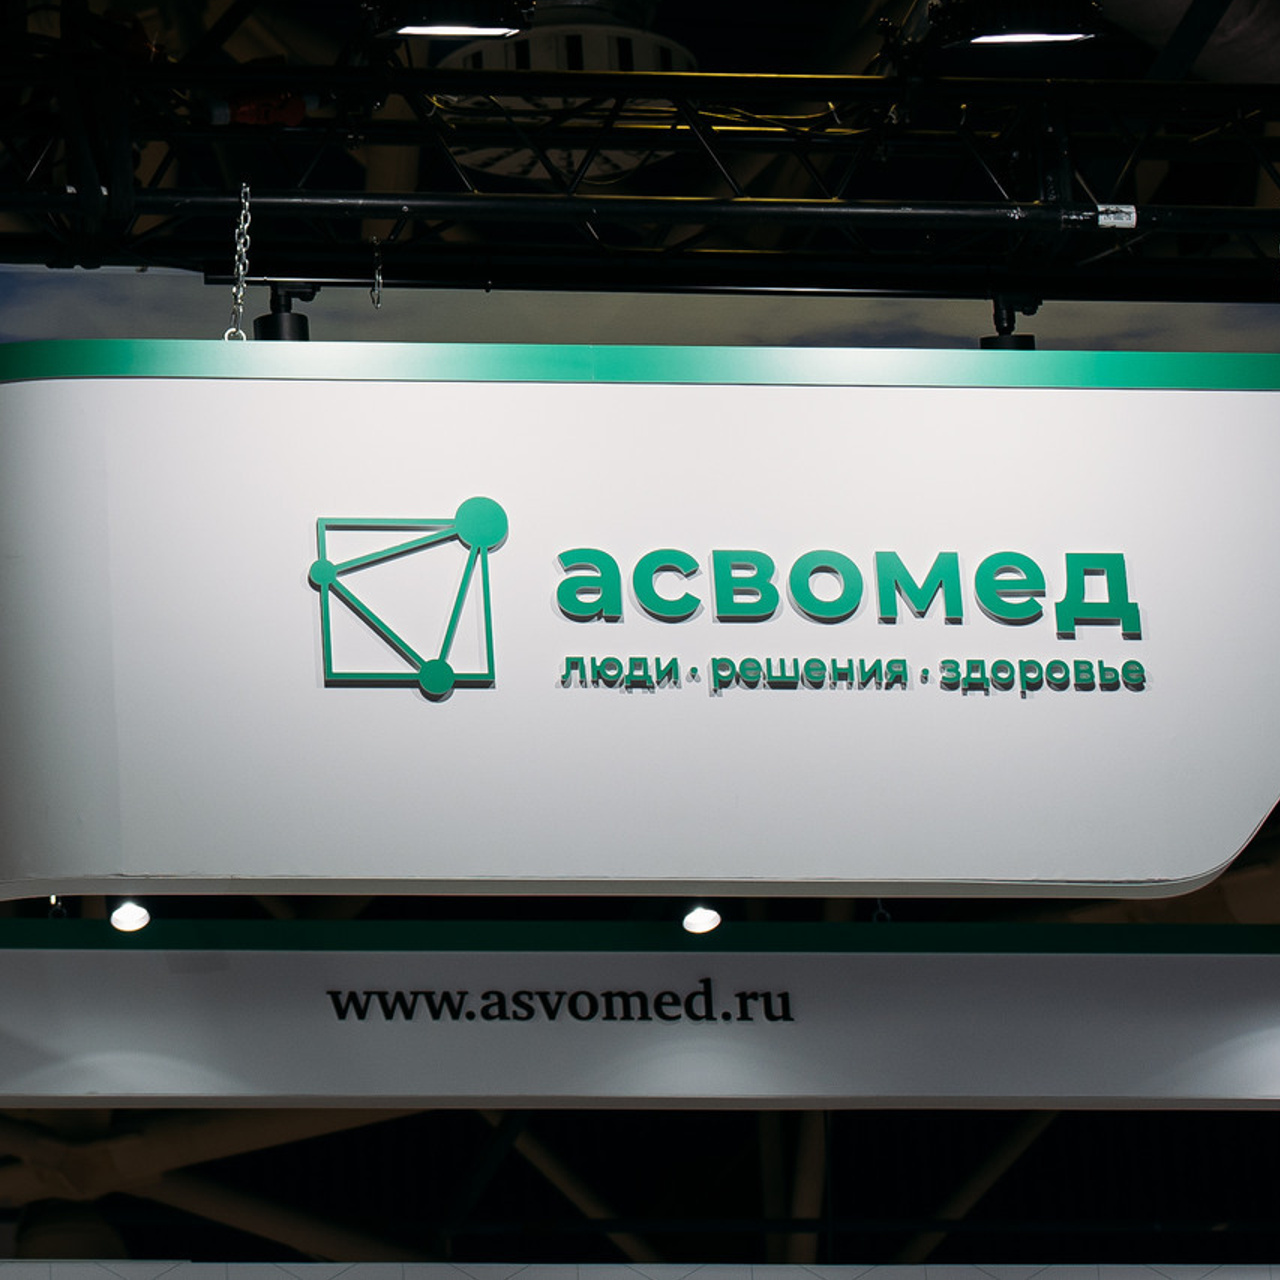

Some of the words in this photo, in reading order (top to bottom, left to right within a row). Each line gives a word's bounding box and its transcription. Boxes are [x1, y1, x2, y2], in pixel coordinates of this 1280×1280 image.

[556, 547, 1144, 636] асвомед
[561, 656, 681, 689] люди
[710, 657, 910, 693] решения
[940, 658, 1146, 694] здоровье
[326, 976, 795, 1022] www.asvomed.ru
